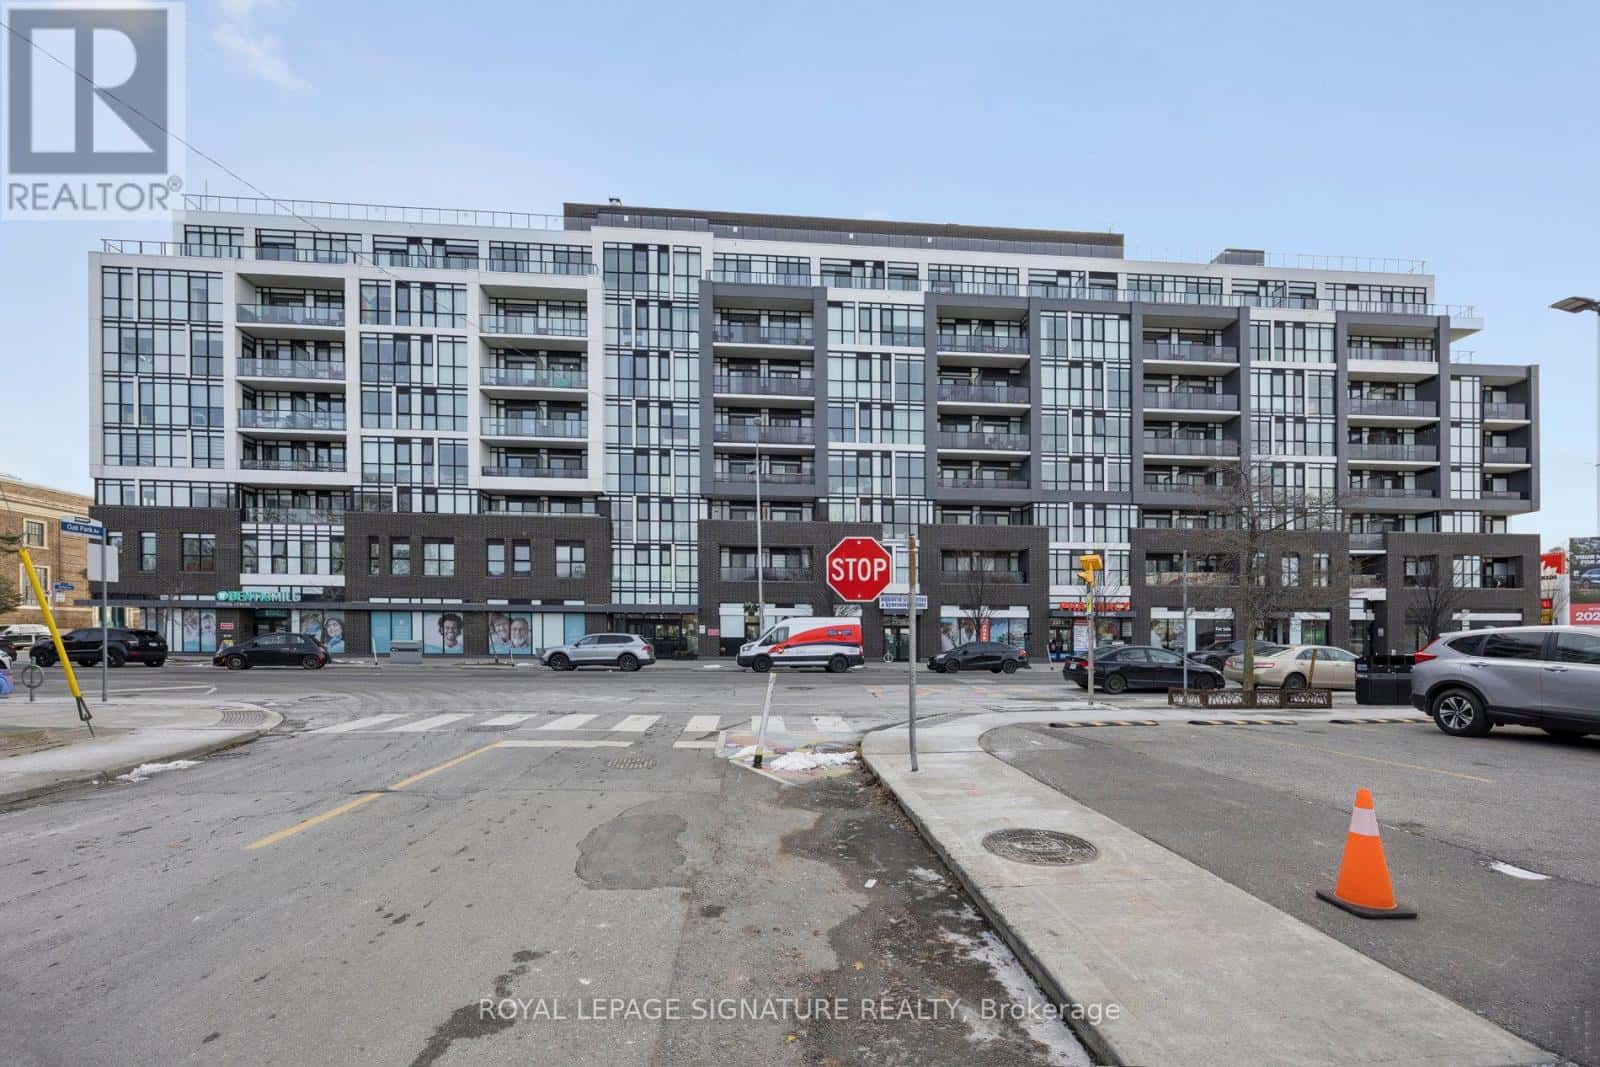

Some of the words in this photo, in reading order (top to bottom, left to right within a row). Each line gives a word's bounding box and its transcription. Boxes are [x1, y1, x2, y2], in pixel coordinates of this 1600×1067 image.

[79, 525, 93, 533] Park
[831, 557, 888, 582] STOP
[1059, 602, 1131, 612] PHAMACY
